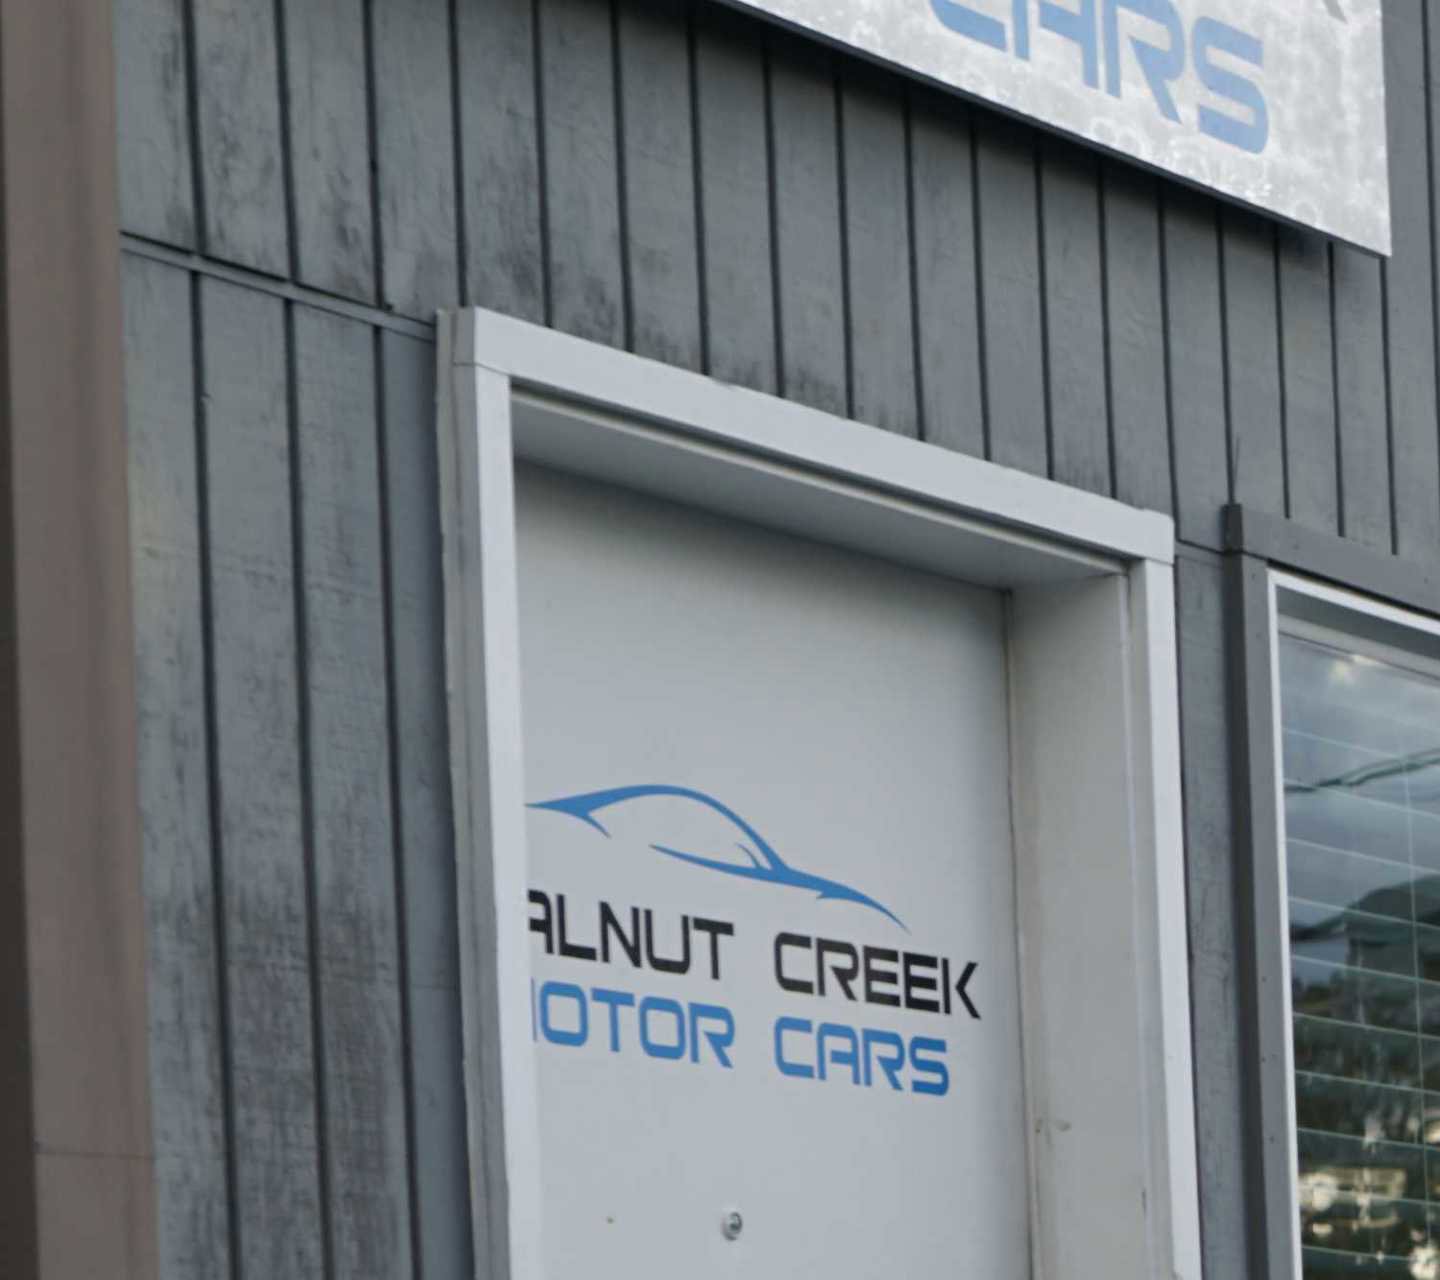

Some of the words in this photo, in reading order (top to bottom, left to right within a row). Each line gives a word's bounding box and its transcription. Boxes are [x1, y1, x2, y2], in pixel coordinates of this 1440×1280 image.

[527, 888, 735, 980] ALNUT
[773, 931, 981, 1020] CREEK
[531, 977, 736, 1069] OTOR
[773, 1015, 950, 1097] CARS
